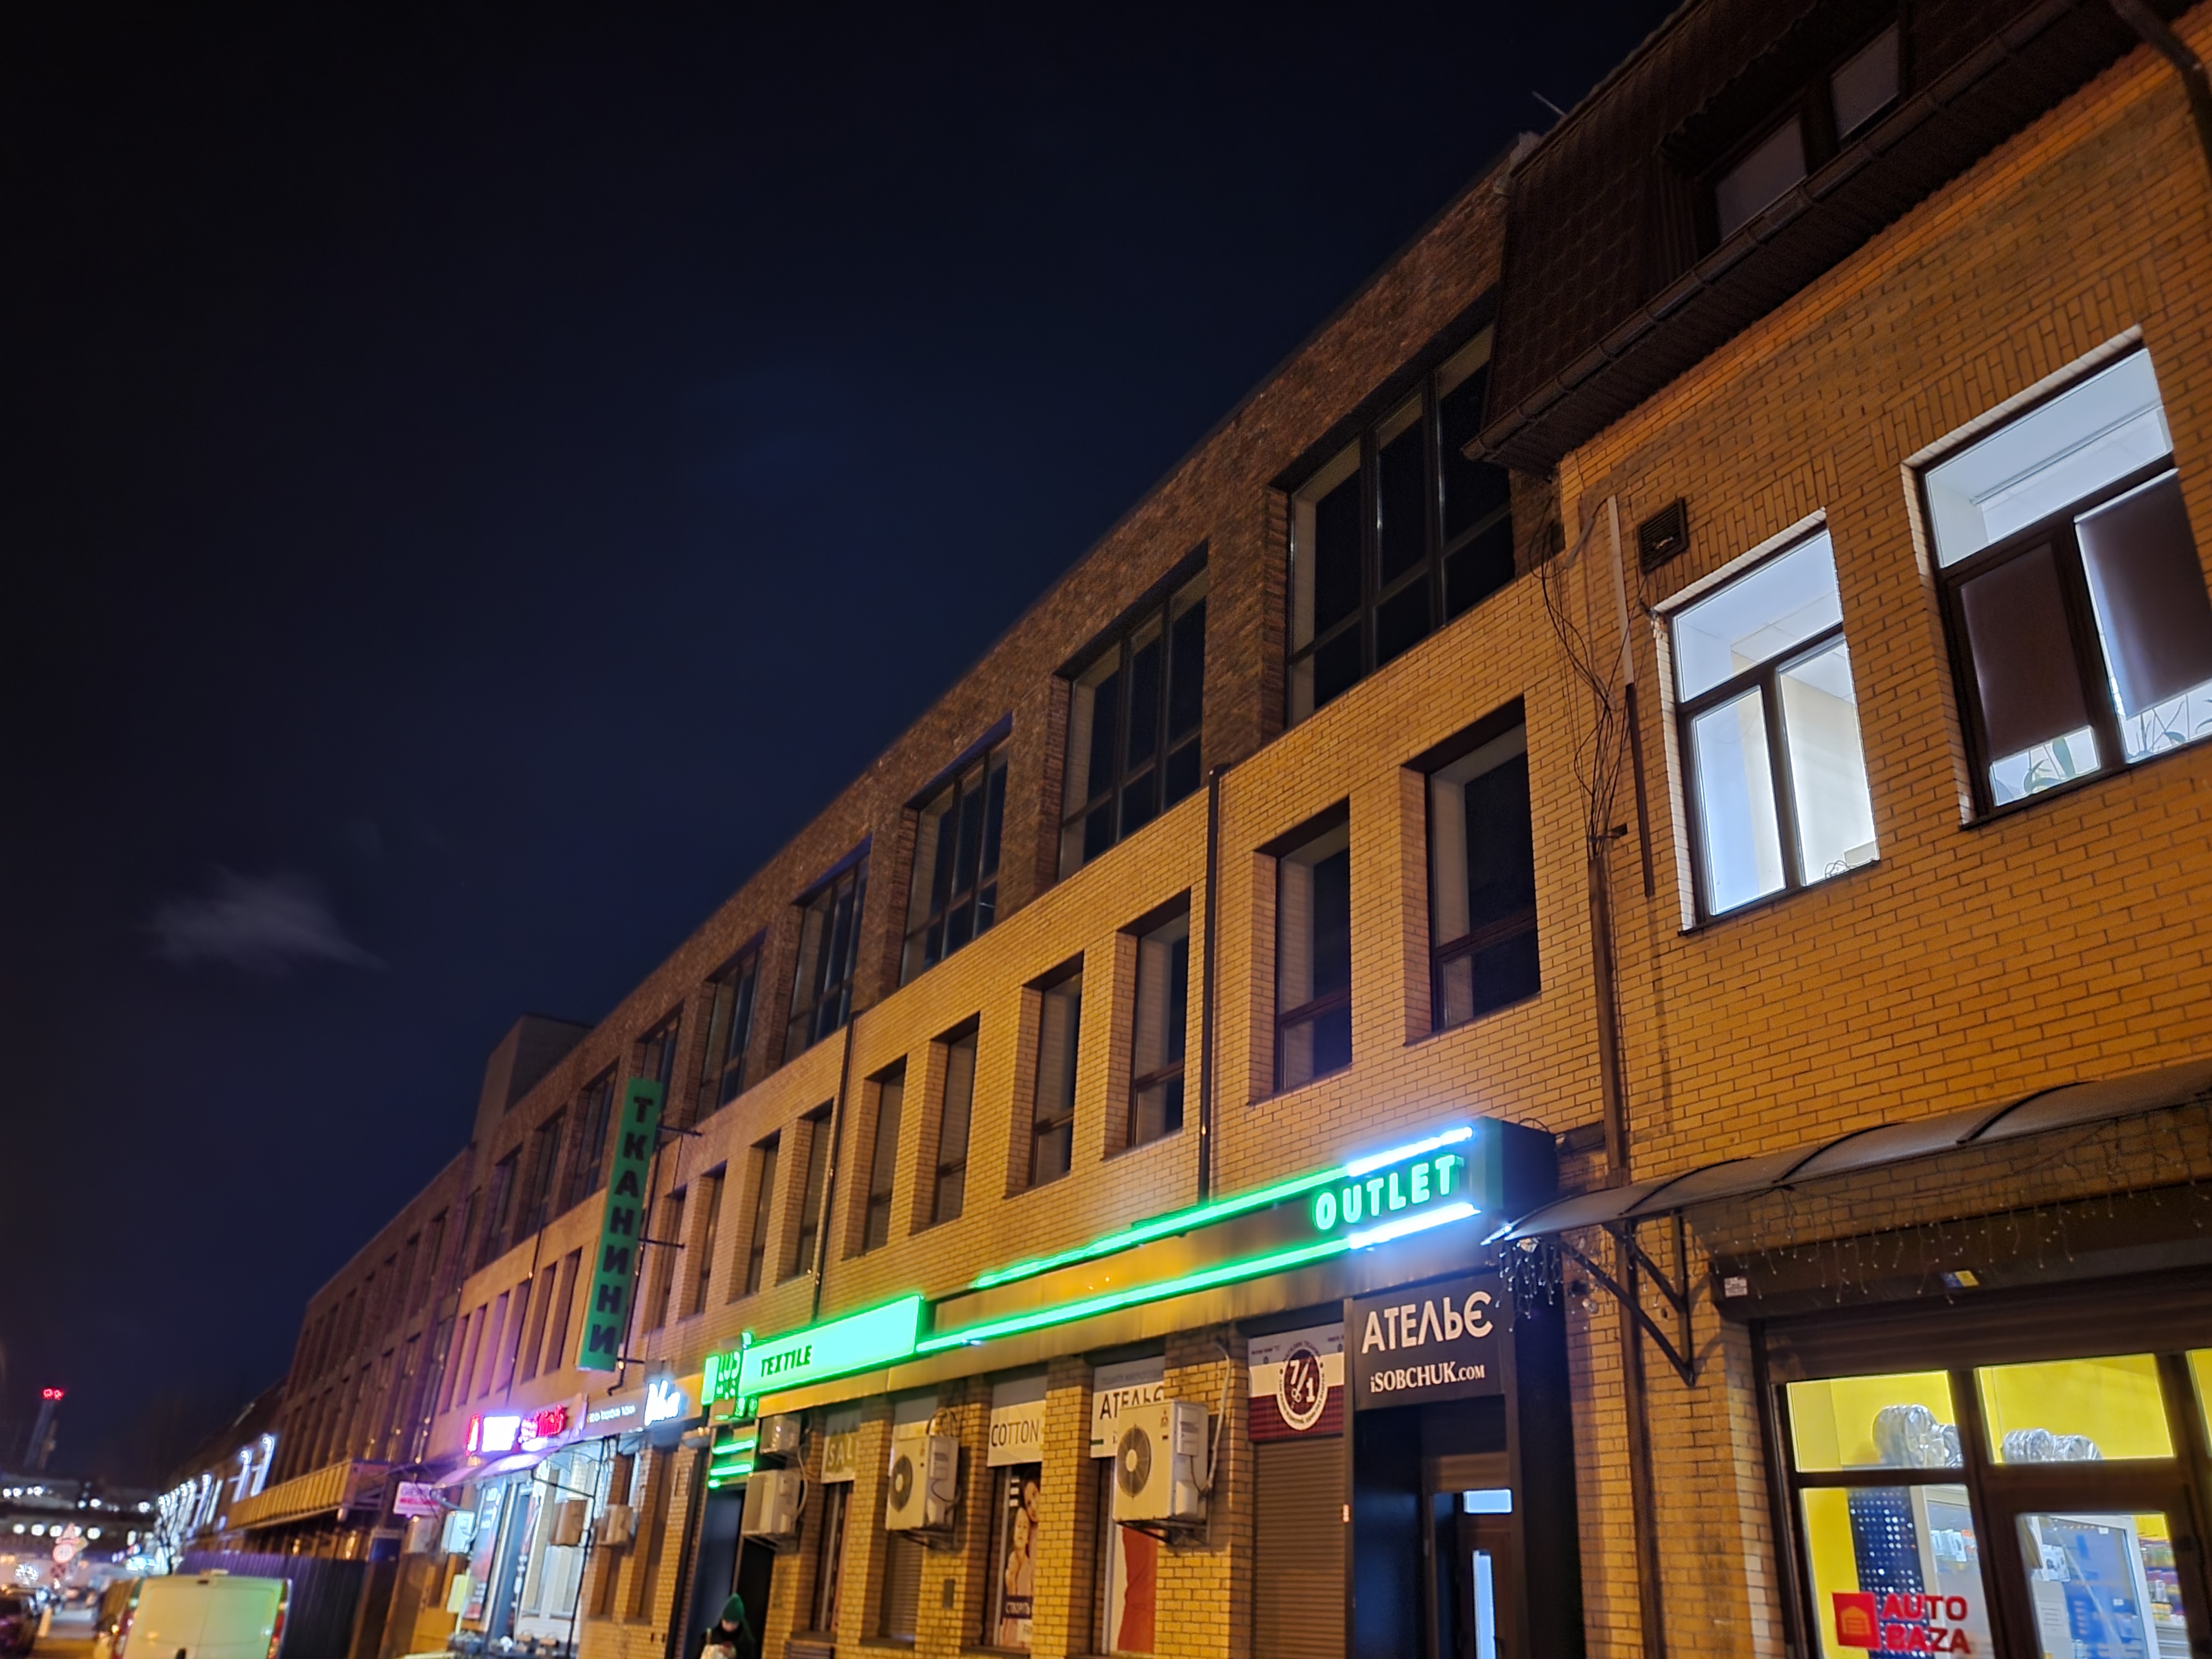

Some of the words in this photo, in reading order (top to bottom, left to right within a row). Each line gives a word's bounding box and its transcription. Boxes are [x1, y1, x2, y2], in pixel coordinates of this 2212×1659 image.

[1315, 1154, 1457, 1230] OUTLET
[588, 1095, 654, 1355] ТКАНИНИ
[1361, 1291, 1494, 1354] АТЕЛЬЄ
[760, 1344, 812, 1378] TEXTILE
[991, 1419, 1039, 1447] COTTON
[828, 1436, 853, 1467] SAL
[1881, 1593, 1968, 1621] AUTO
[1885, 1625, 1971, 1654] BAZA
